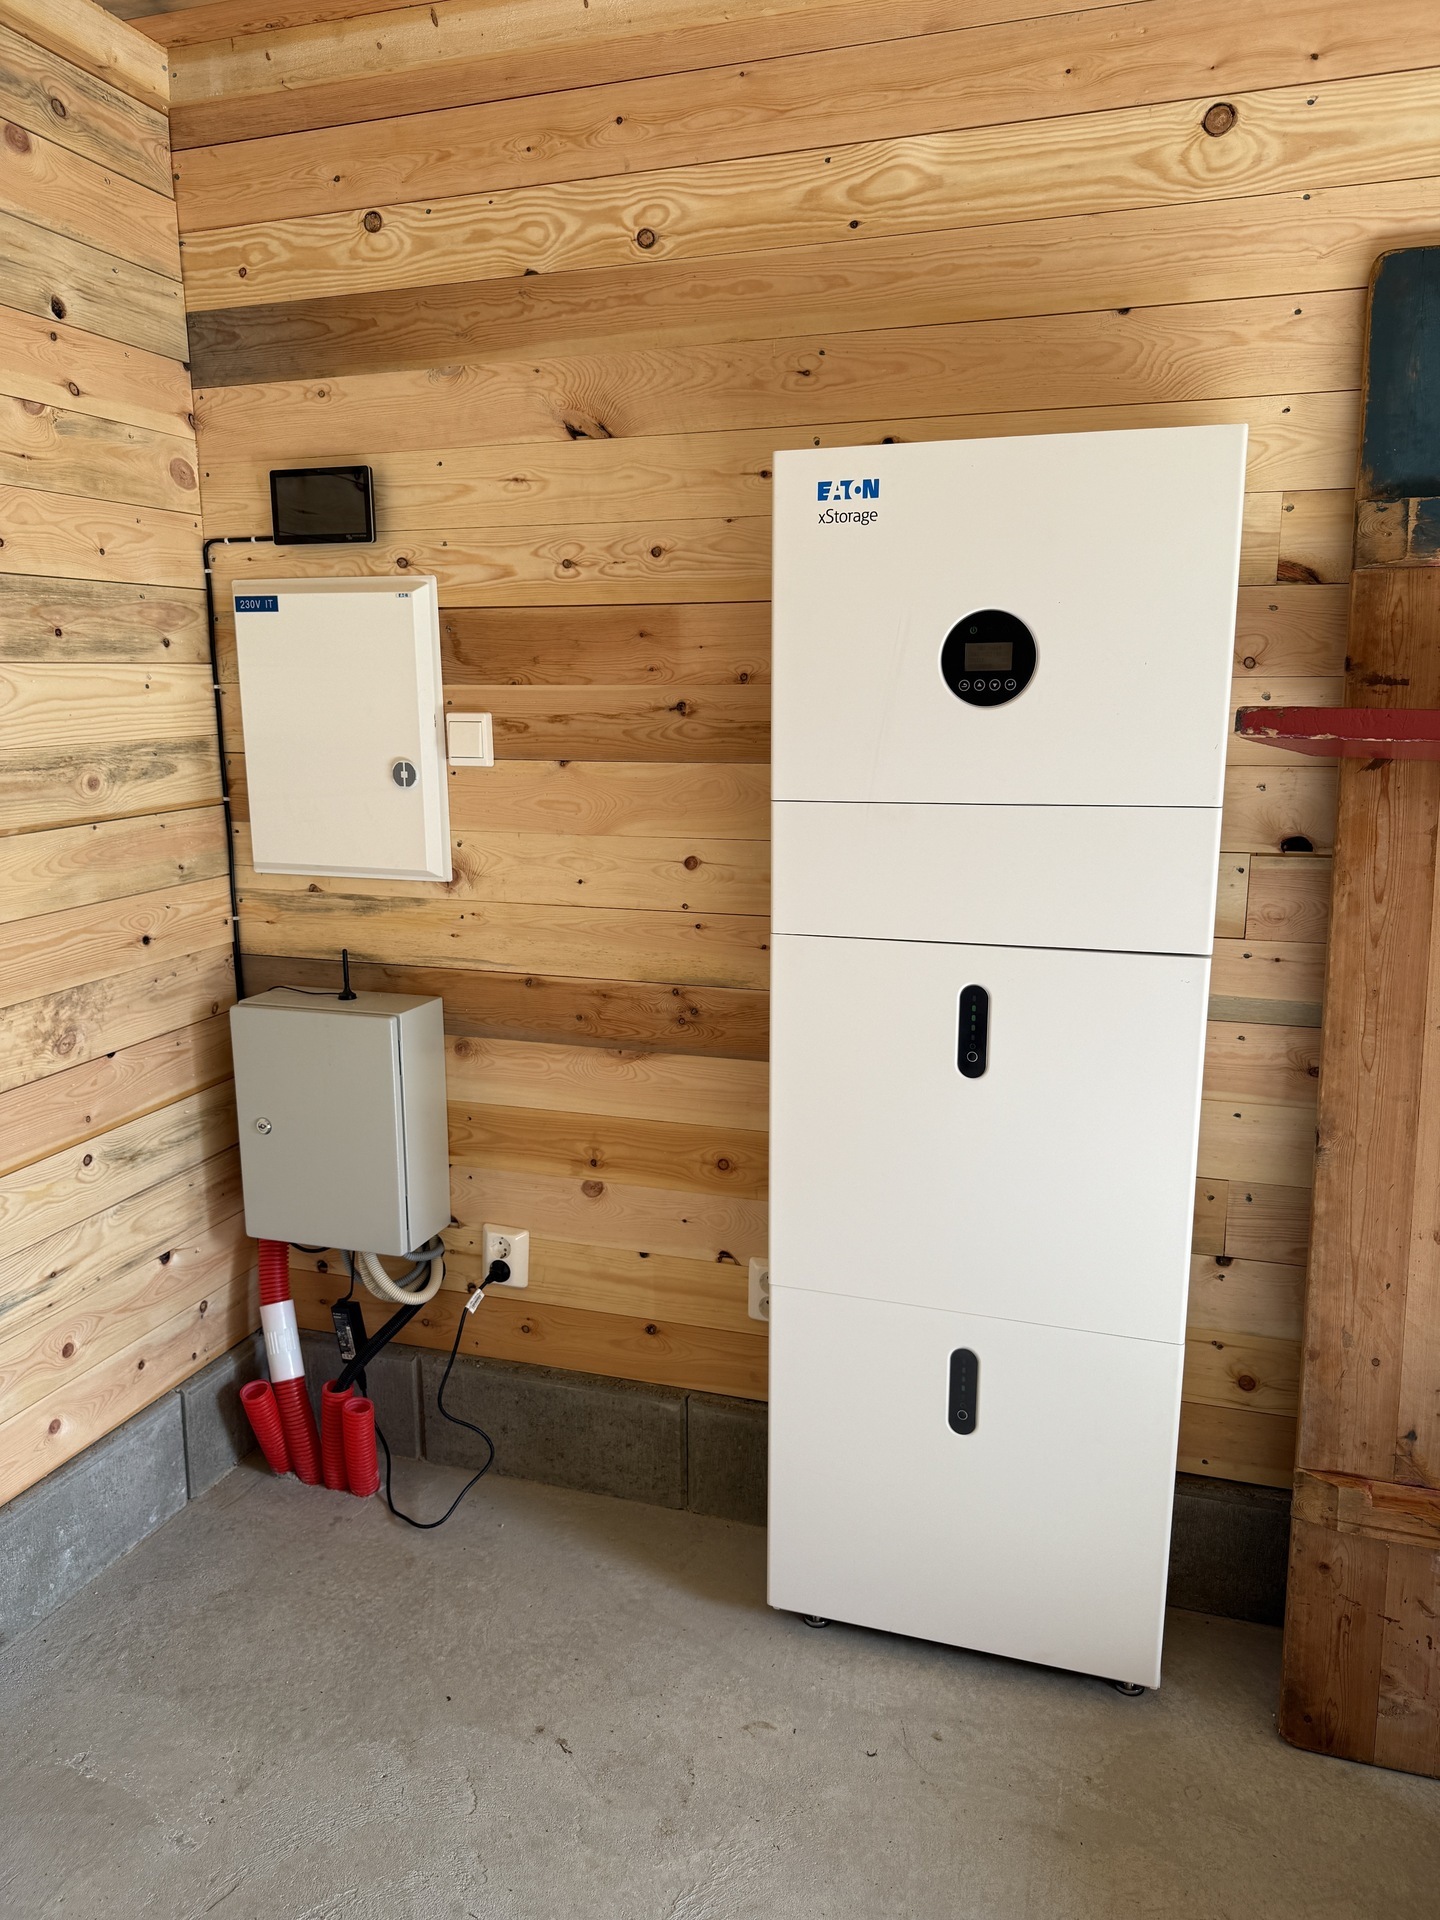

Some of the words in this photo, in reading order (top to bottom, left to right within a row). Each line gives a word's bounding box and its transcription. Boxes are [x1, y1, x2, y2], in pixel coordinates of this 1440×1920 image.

[817, 478, 880, 501] EATON
[818, 508, 878, 526] xStorage
[240, 599, 261, 609] 230V
[265, 599, 274, 609] IT
